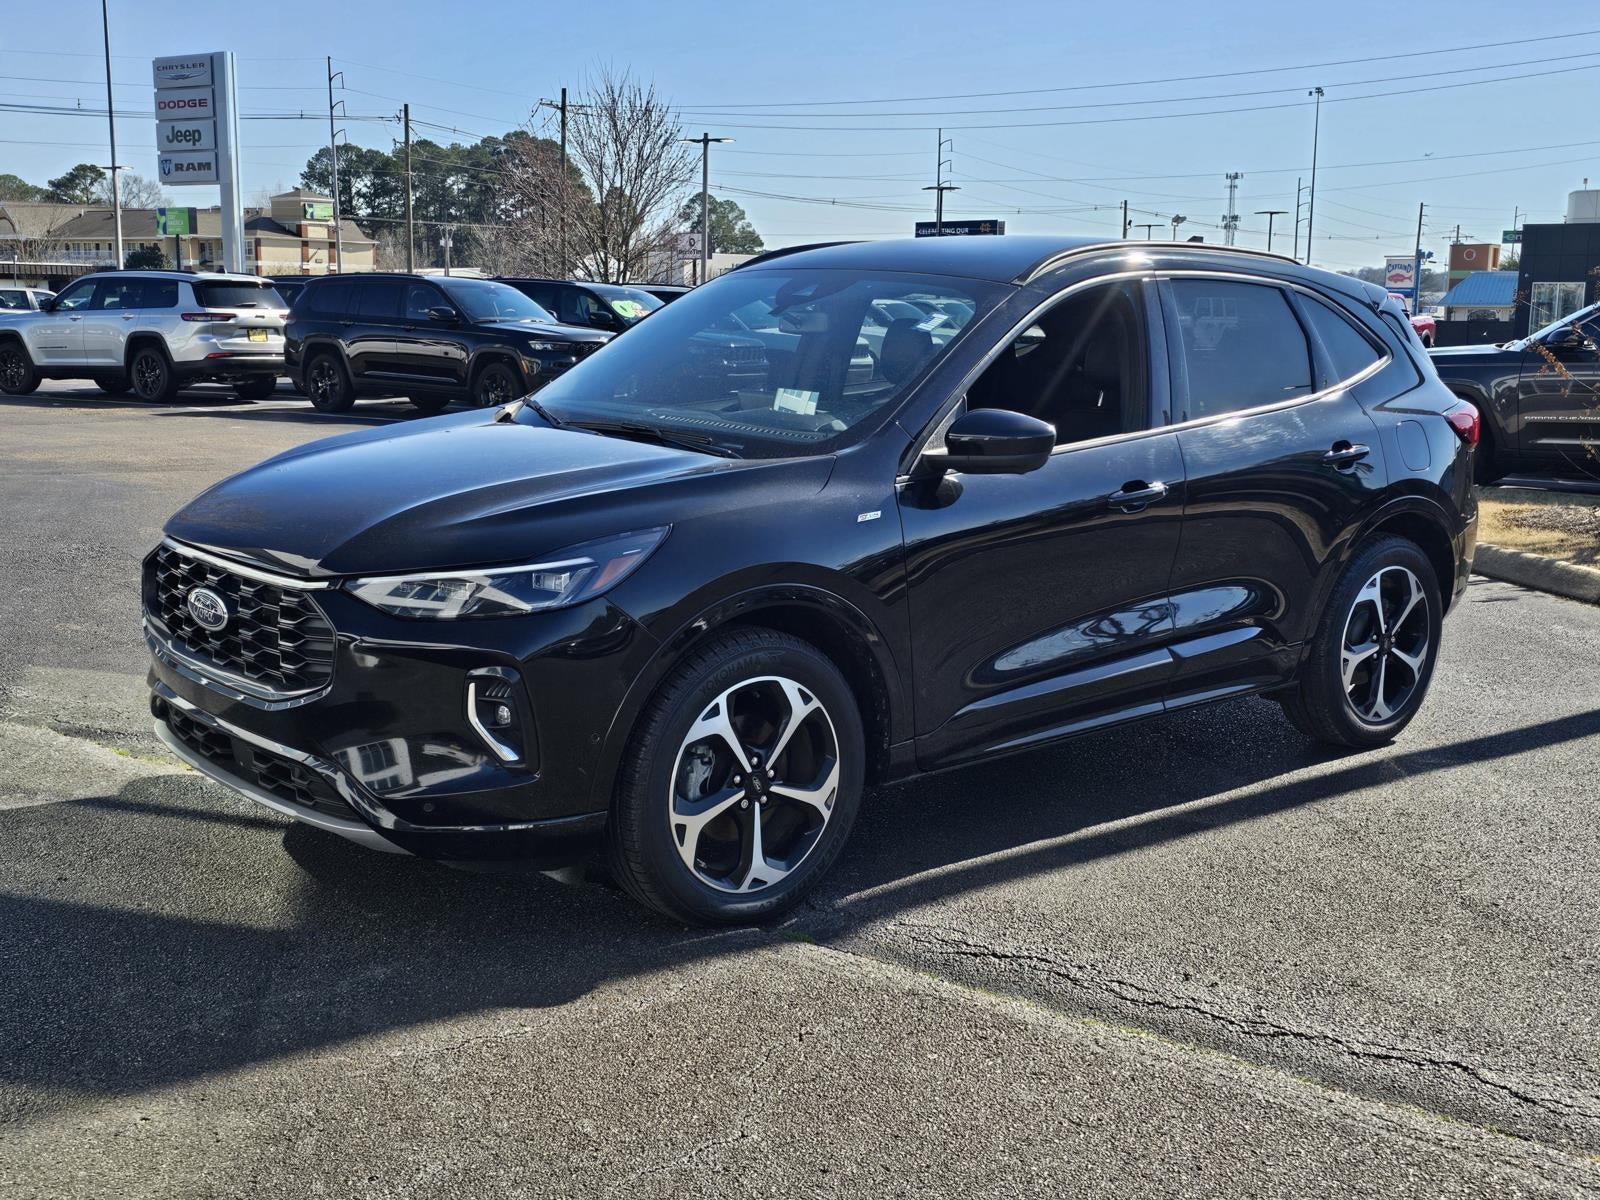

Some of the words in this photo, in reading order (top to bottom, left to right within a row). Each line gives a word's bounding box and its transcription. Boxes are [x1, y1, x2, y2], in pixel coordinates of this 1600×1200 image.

[156, 62, 205, 71] CHRYSLER
[158, 98, 208, 110] DODGE
[166, 125, 202, 146] Jeep
[174, 162, 212, 172] RAM
